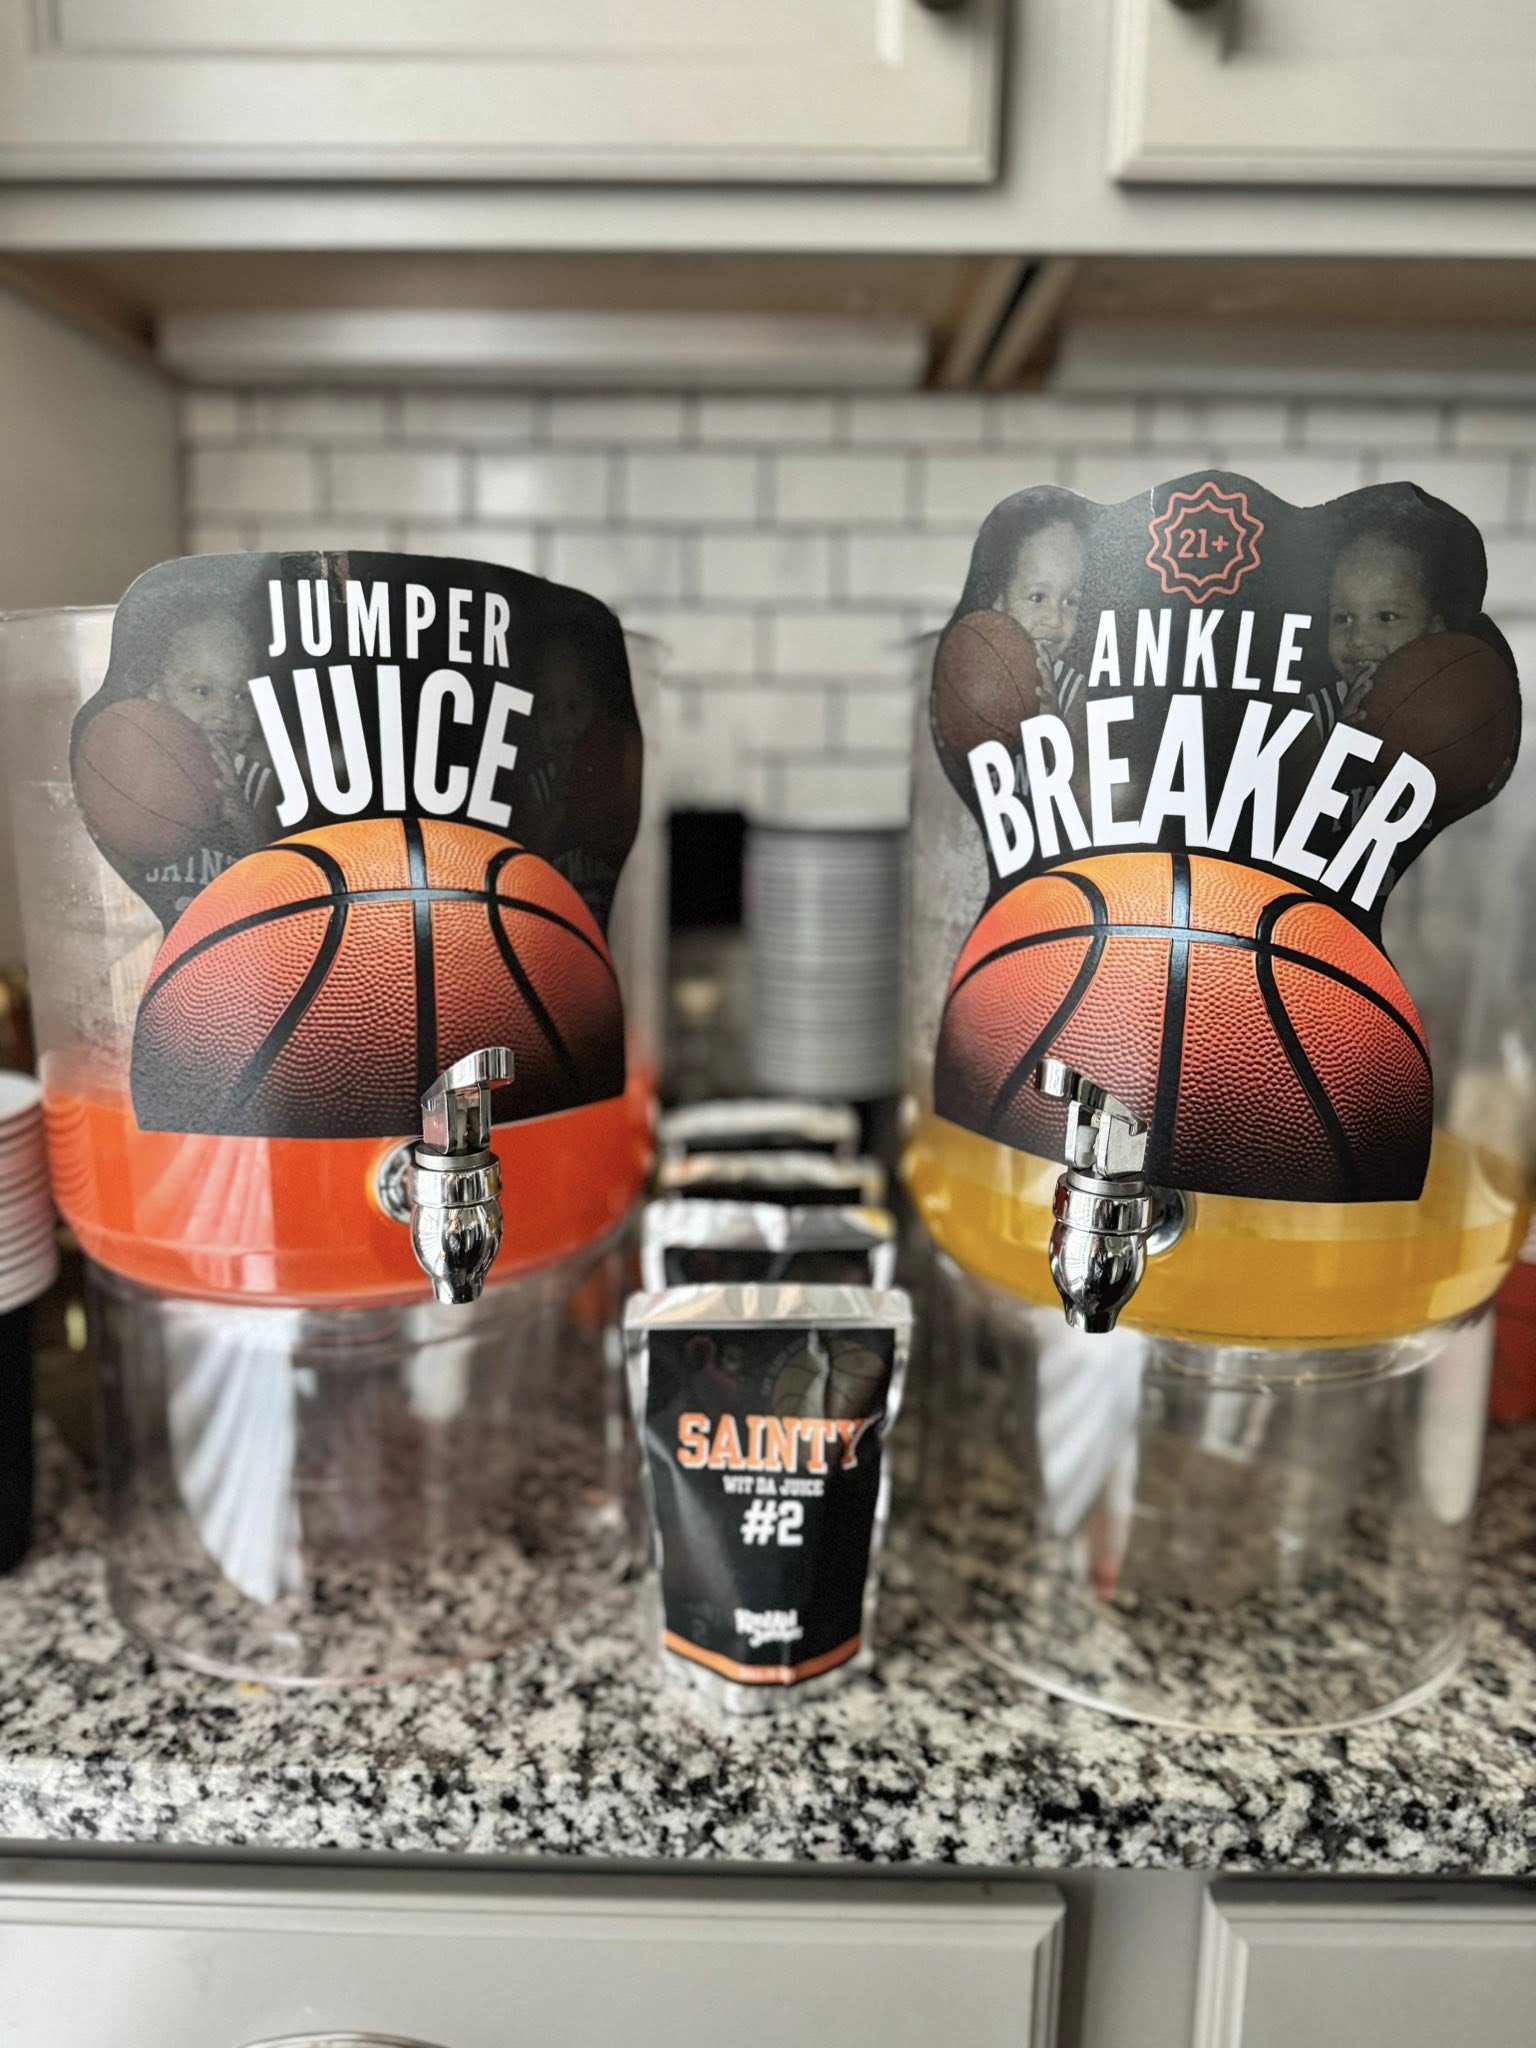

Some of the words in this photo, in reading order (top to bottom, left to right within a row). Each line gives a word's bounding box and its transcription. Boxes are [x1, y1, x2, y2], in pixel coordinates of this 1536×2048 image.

[1178, 528, 1229, 558] 21+
[268, 579, 511, 668] JUMPER
[1088, 609, 1312, 693] ANKLE
[248, 664, 534, 828] JUICE
[967, 694, 1437, 911] BREAKER
[677, 1412, 867, 1474] SAINTY
[740, 1499, 804, 1547] #2
